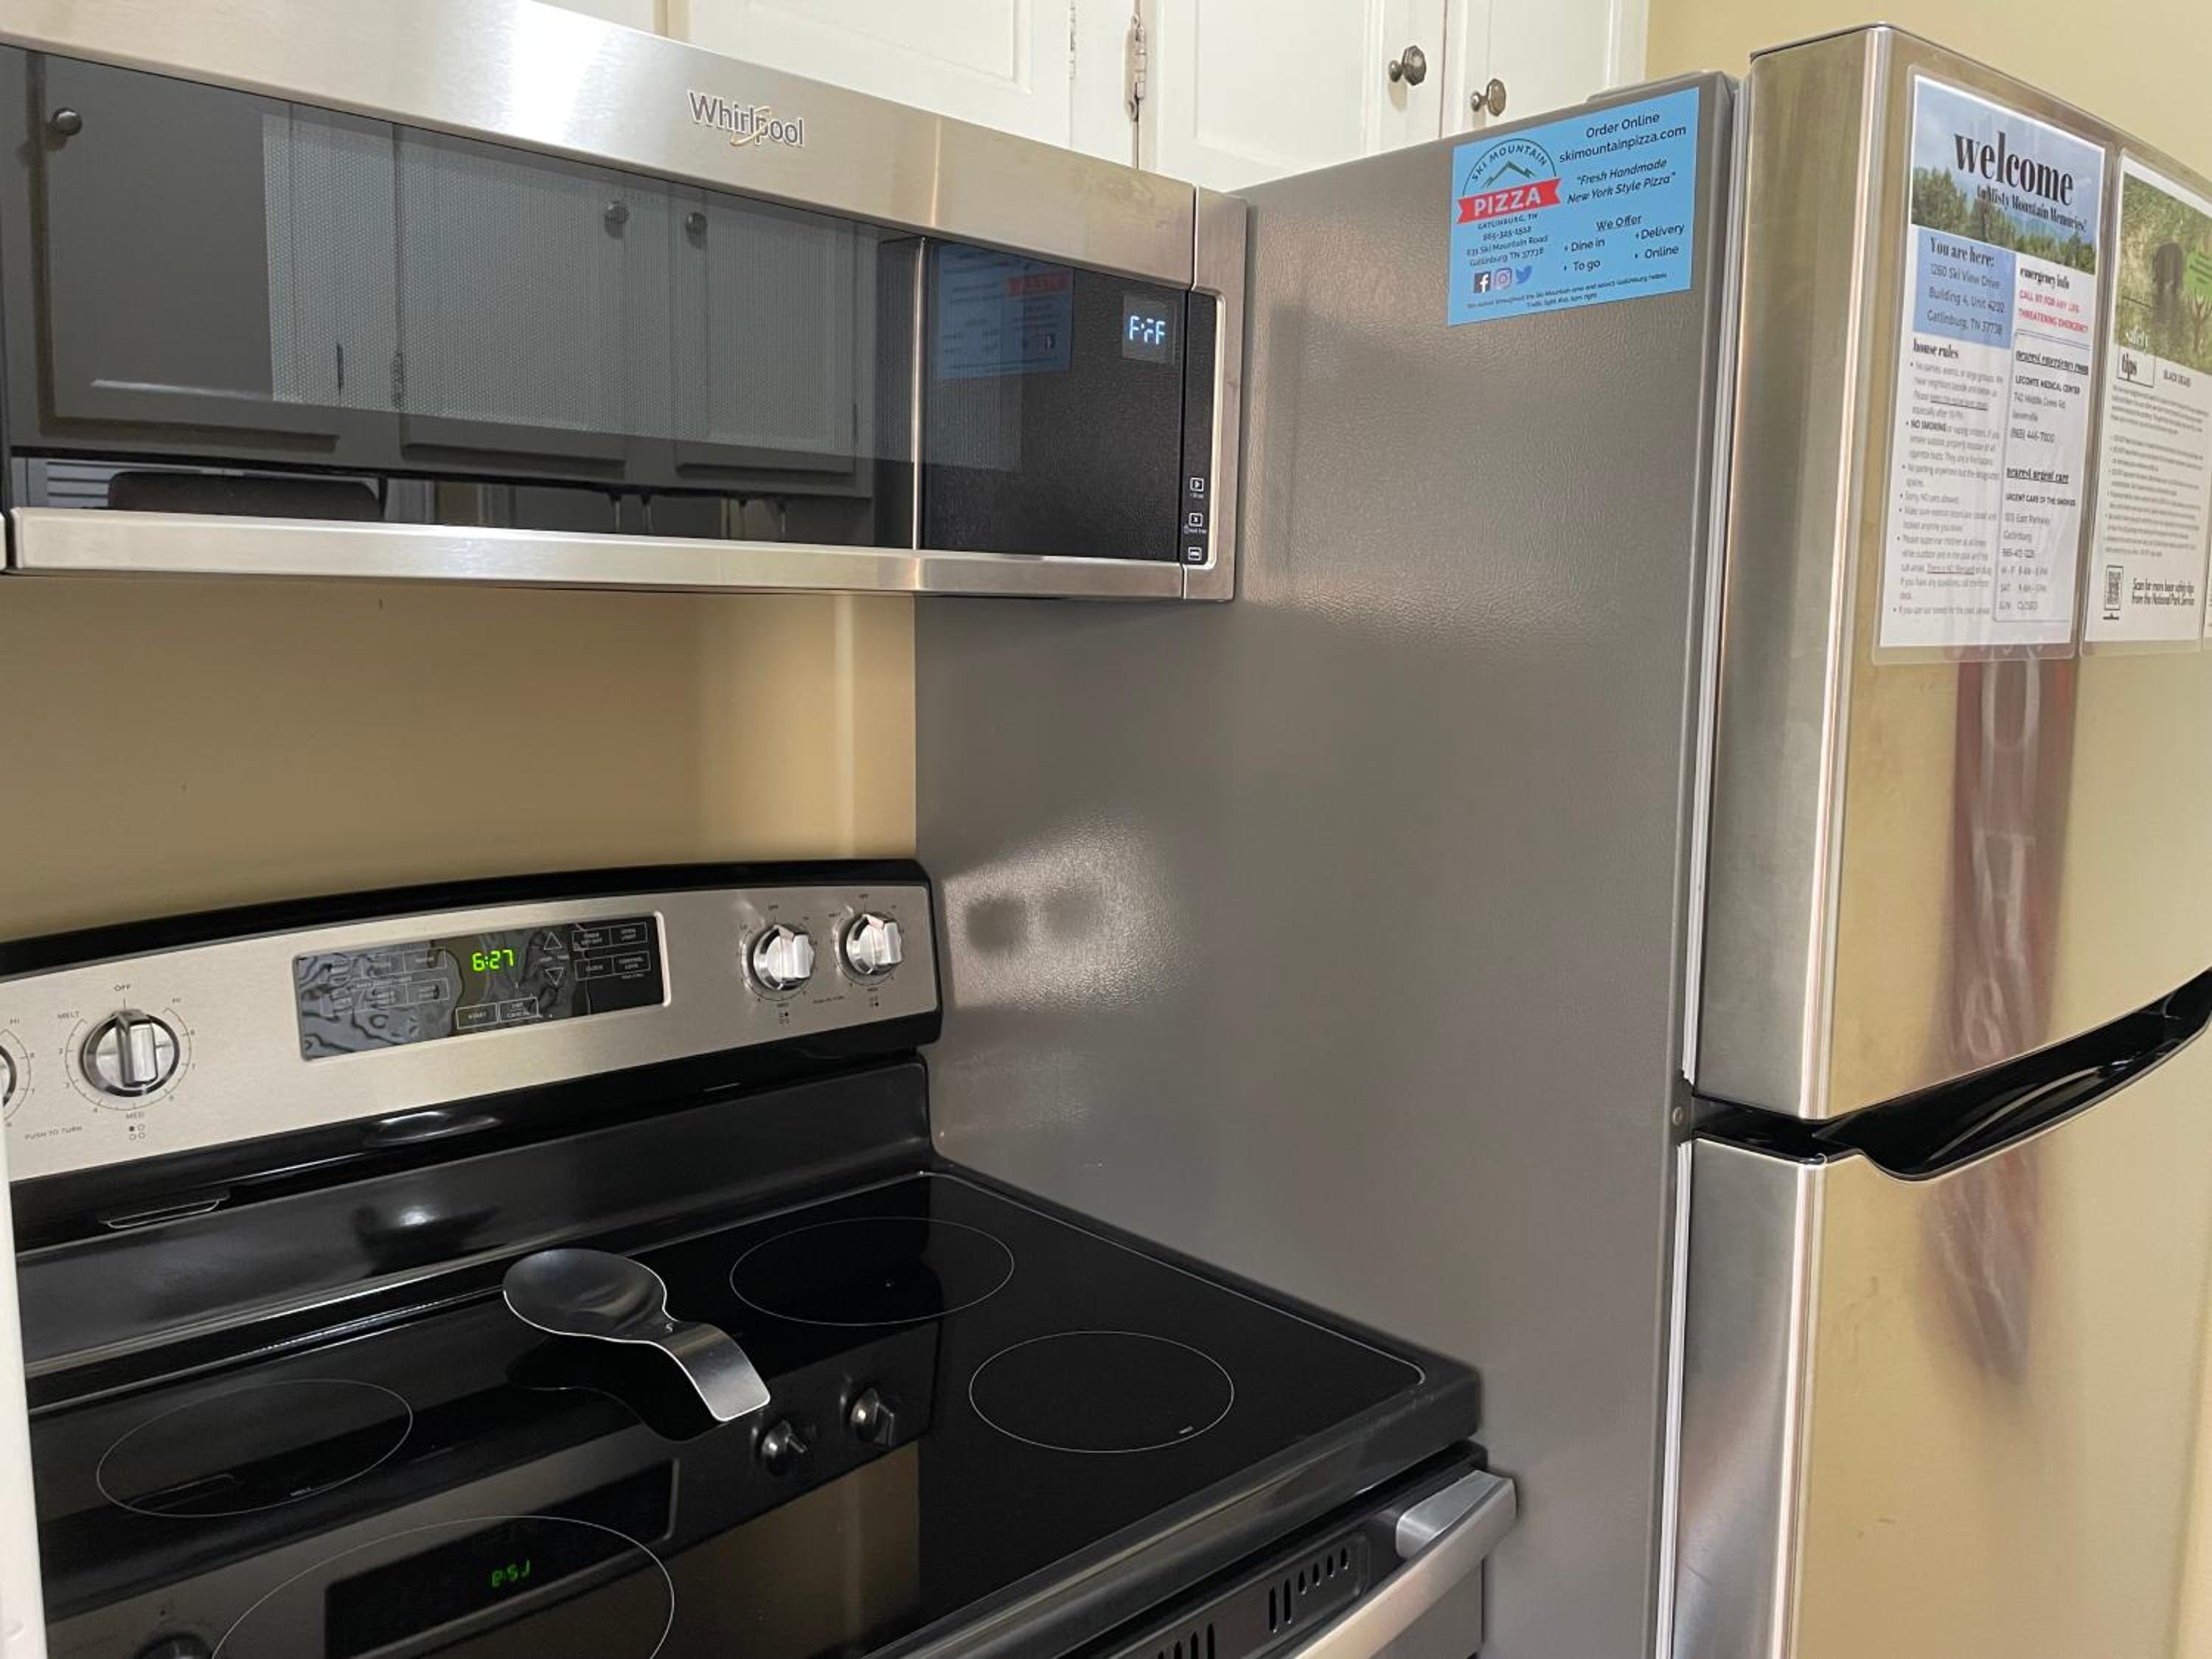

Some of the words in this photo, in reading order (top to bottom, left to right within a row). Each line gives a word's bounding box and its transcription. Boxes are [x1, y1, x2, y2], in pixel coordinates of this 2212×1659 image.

[688, 91, 804, 147] Whirlpool
[1586, 123, 1619, 138] Order
[1621, 114, 1660, 130] Online
[1559, 126, 1686, 163] skimountainpizza.com
[1472, 162, 1486, 181] SKI
[1489, 145, 1547, 166] MOUNTAIN
[1609, 159, 1667, 178] Handmade
[1954, 131, 2073, 206] welcome
[1475, 187, 1541, 217] PIZZA
[1567, 191, 1590, 204] New
[1592, 187, 1613, 199] York
[1615, 181, 1642, 195] Style
[2012, 195, 2049, 218] Mountain
[1596, 220, 1613, 231] We
[1615, 215, 1642, 227] Offer
[1641, 224, 1685, 240] Delivery
[1492, 240, 1527, 249] Mountain
[1528, 235, 1548, 243] Road
[1571, 241, 1593, 251] Dine
[1595, 237, 1605, 246] in
[1645, 246, 1679, 259] Online
[1930, 237, 1950, 256] You
[1951, 248, 1968, 259] are
[1969, 246, 1994, 267] here:
[1573, 261, 1585, 271] To
[1587, 260, 1601, 271] go
[473, 950, 514, 971] 6:27
